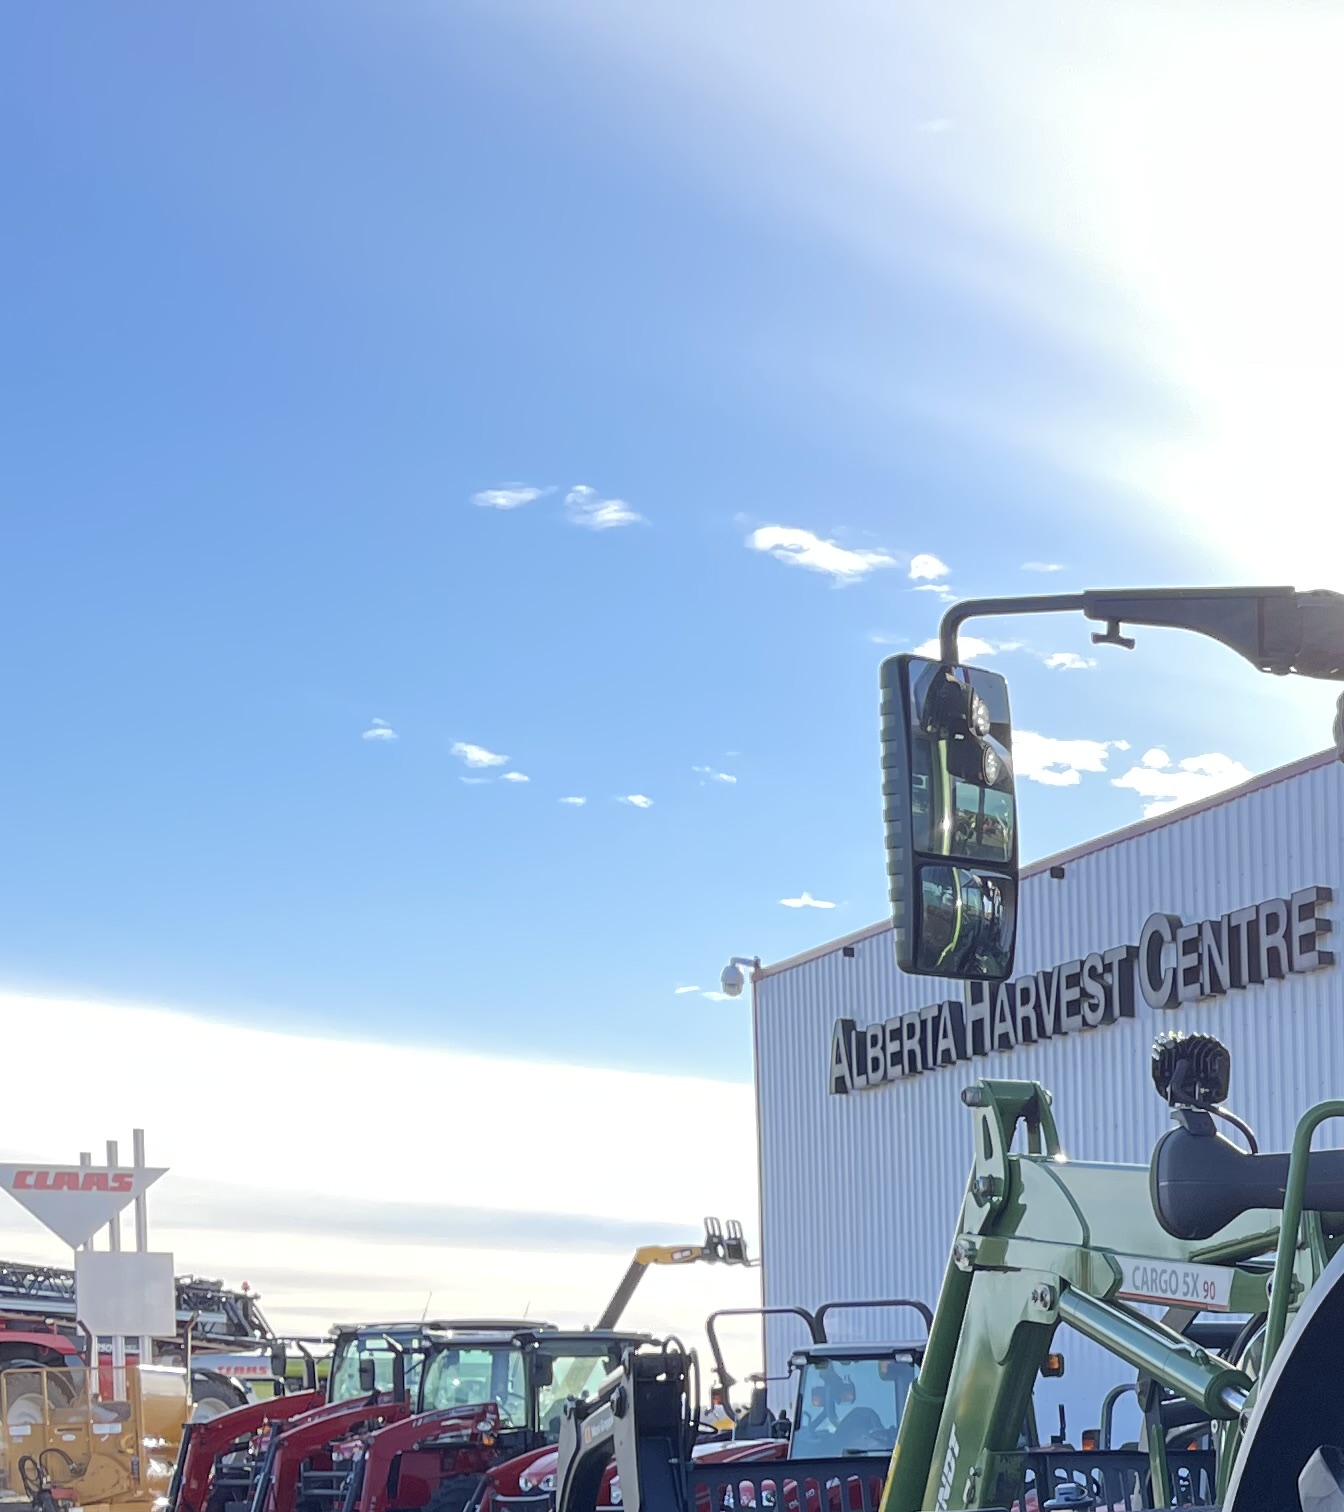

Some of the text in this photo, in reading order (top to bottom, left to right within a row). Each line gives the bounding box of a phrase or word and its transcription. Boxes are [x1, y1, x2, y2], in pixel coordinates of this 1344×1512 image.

[830, 887, 1333, 1094] ALBERTA HARVEST CENTRE
[12, 1170, 134, 1192] CLAAS
[1132, 1265, 1216, 1301] CARGO 5X 90
